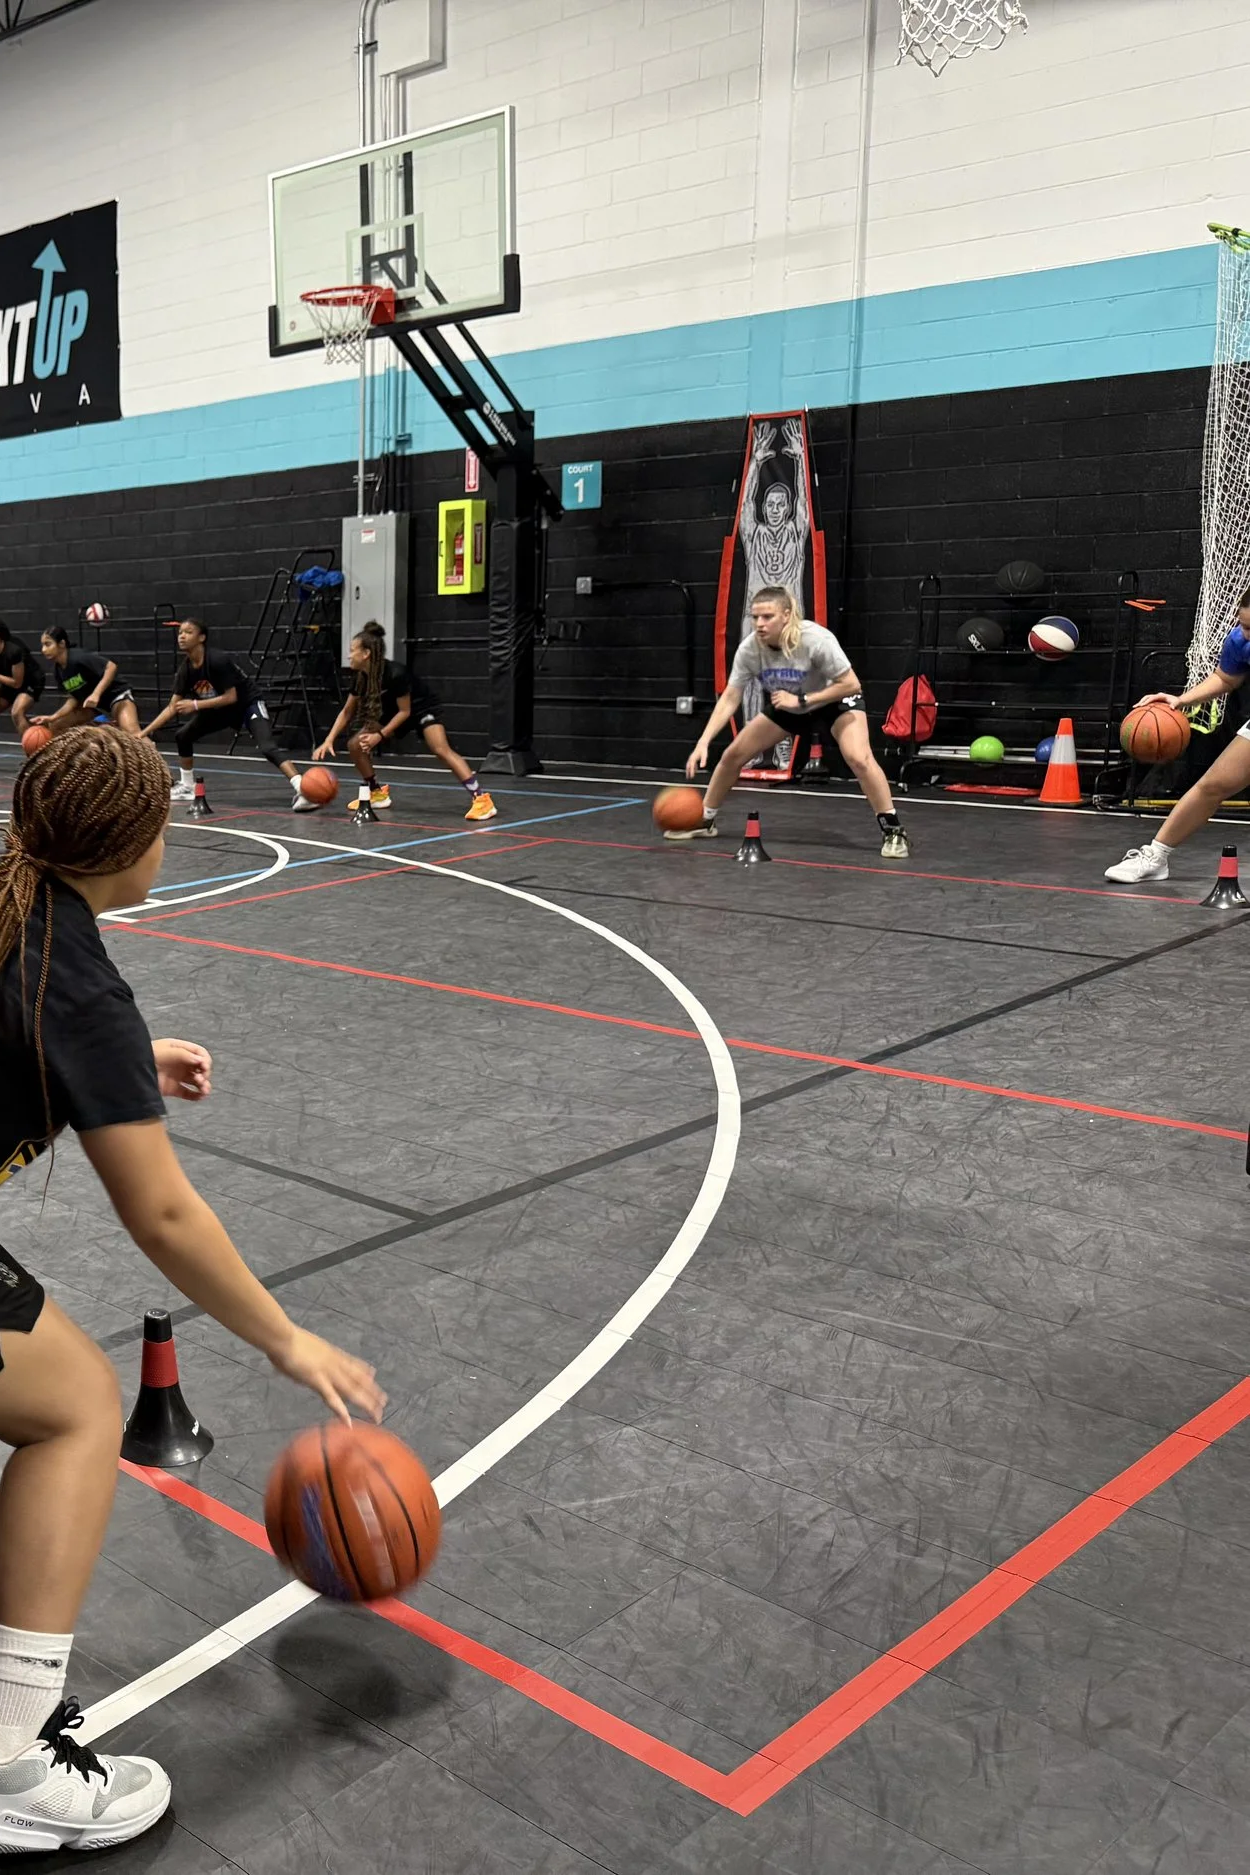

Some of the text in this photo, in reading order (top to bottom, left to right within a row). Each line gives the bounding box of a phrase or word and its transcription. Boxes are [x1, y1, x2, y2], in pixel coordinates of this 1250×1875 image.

[567, 464, 594, 475] COURT
[573, 477, 585, 504] 1
[4, 1815, 35, 1827] FLOW
